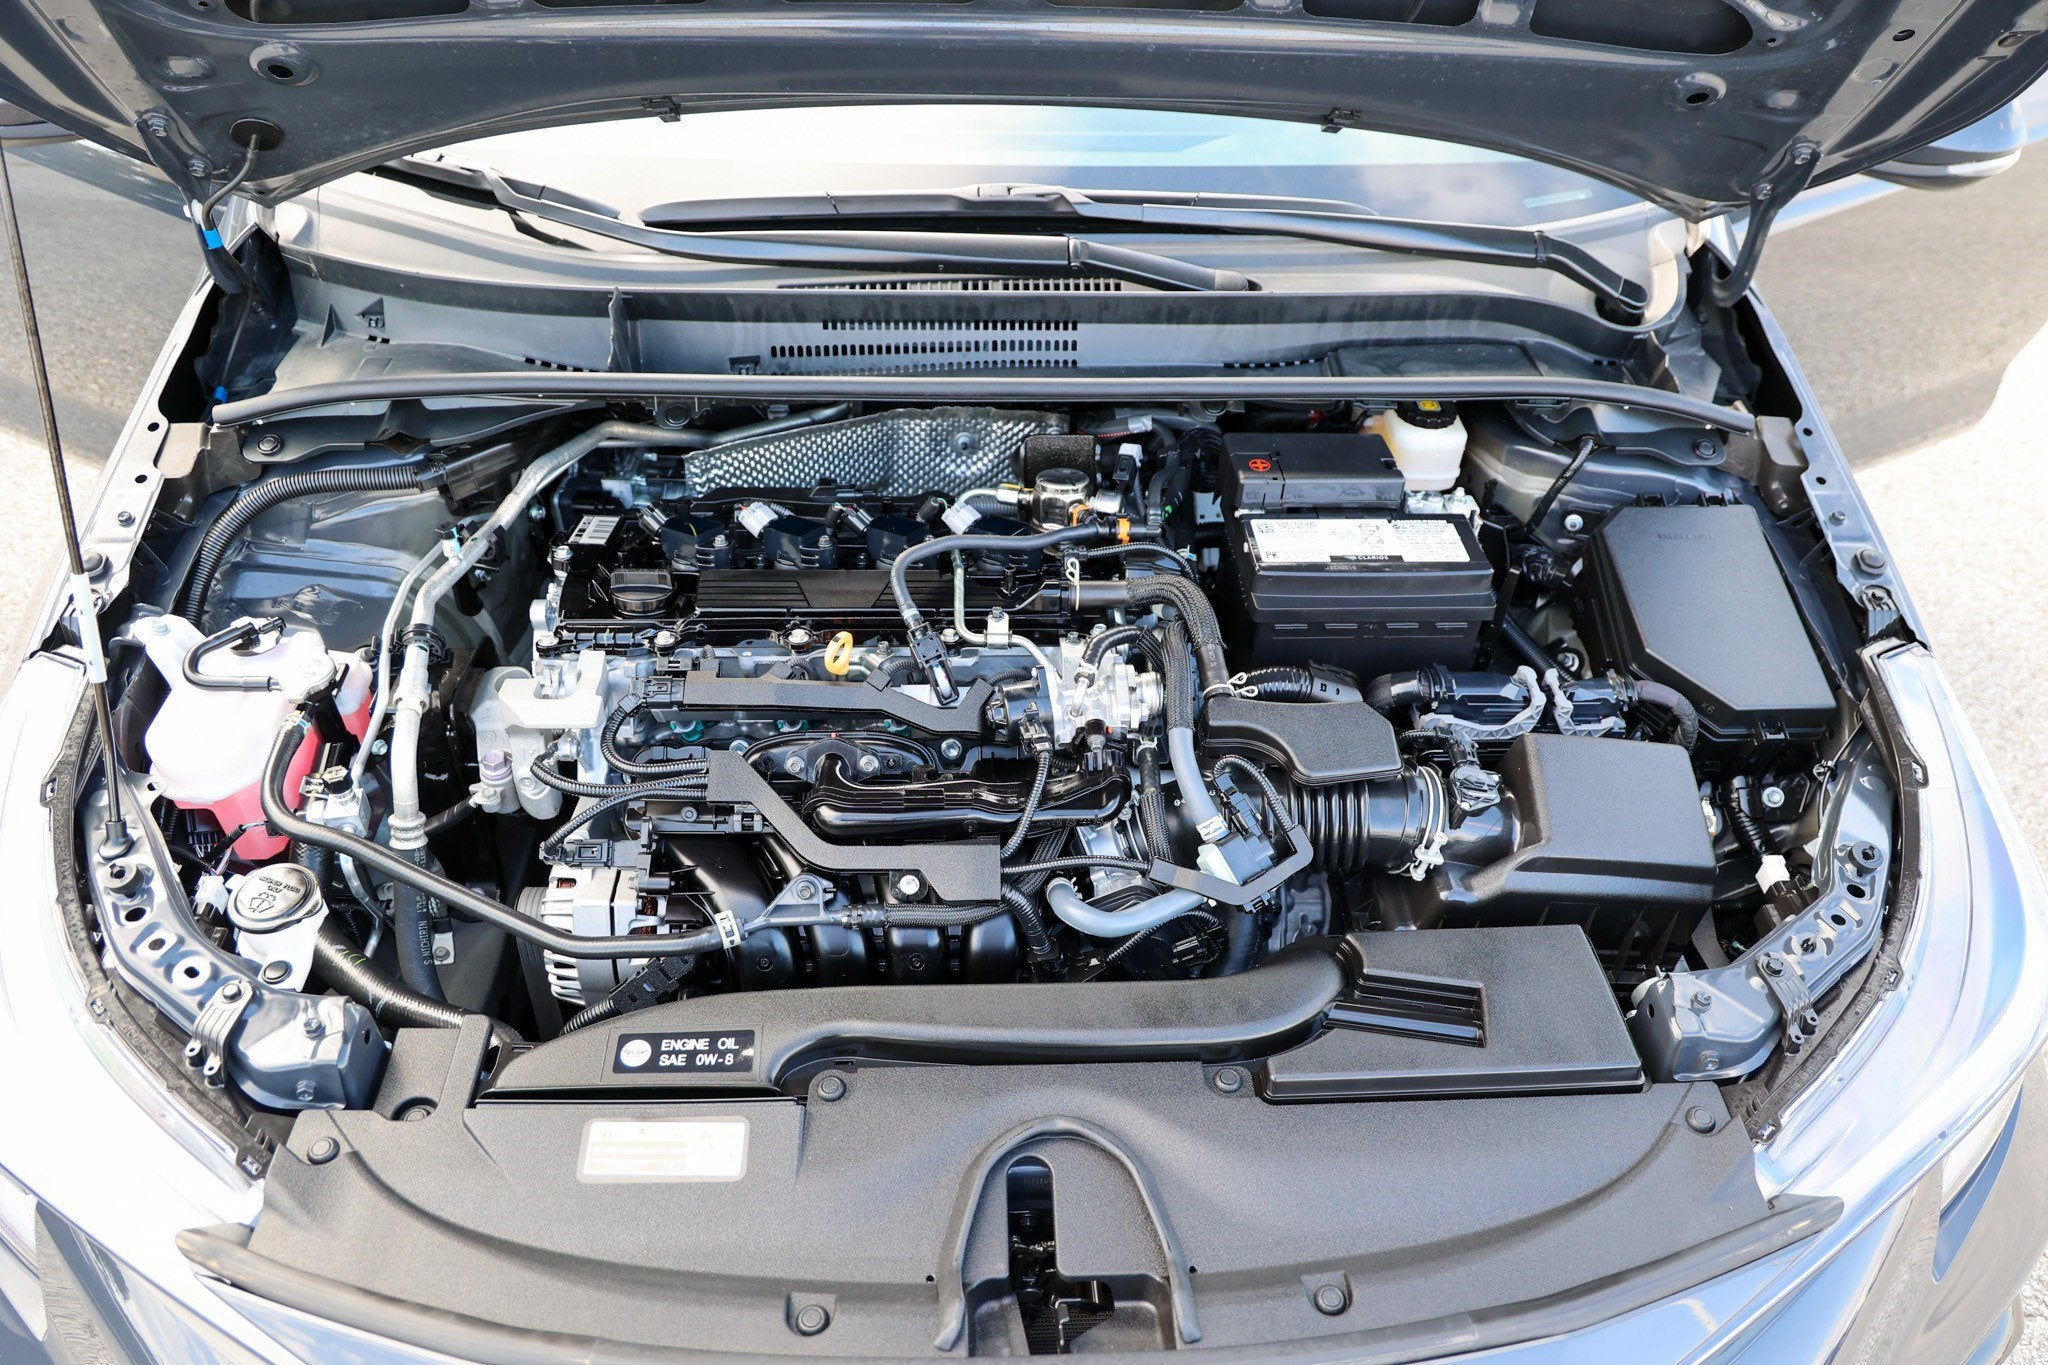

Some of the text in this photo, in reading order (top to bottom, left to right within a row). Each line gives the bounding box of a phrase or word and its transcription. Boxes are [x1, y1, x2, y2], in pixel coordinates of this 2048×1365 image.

[660, 1037, 740, 1051] ENGINE OIL
[658, 1052, 734, 1067] SAE 0W-8
